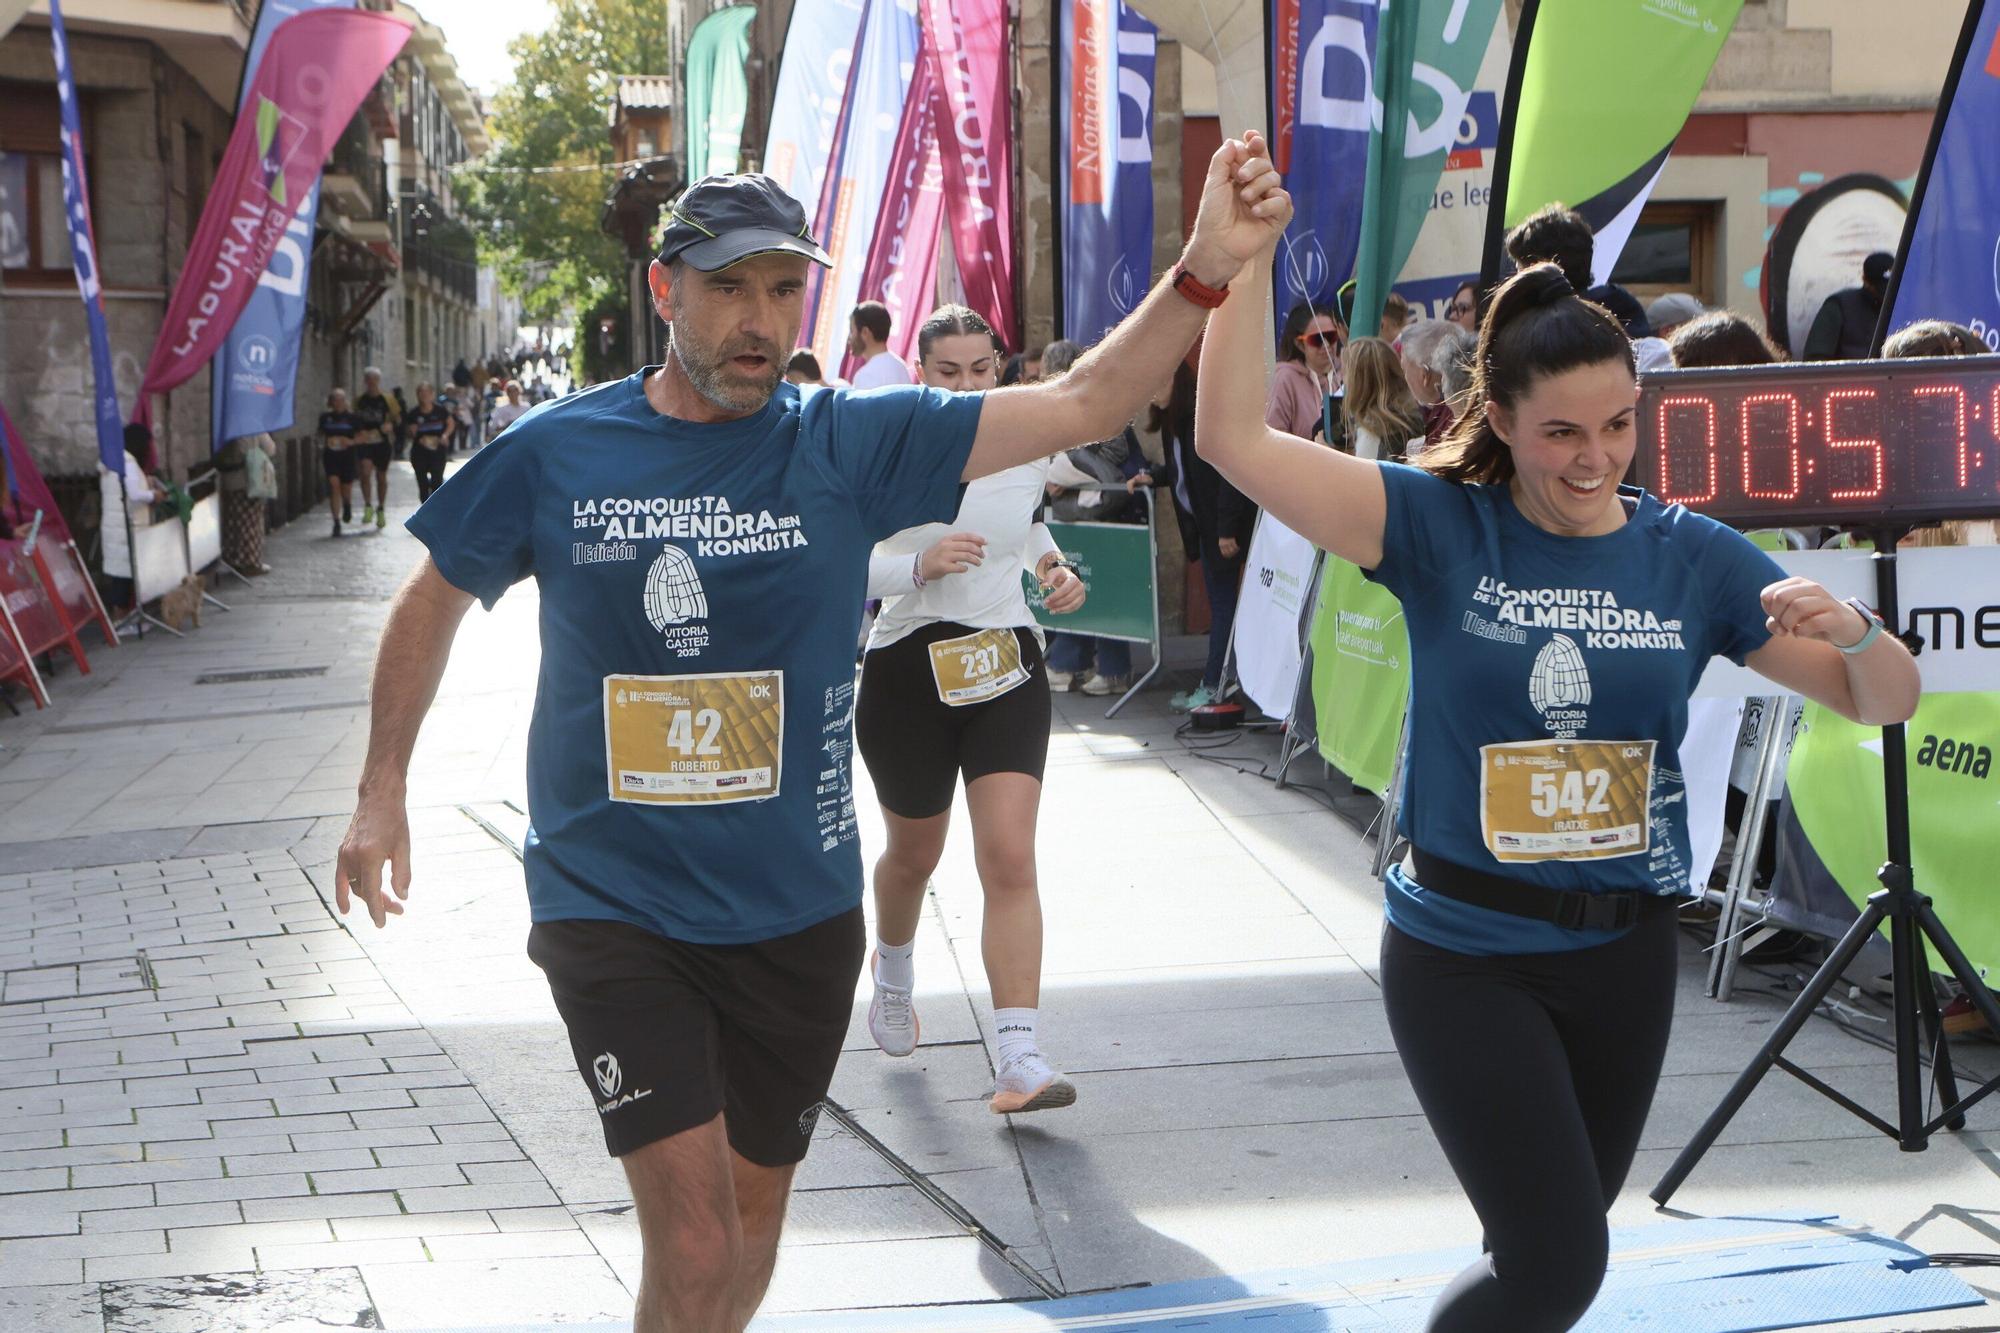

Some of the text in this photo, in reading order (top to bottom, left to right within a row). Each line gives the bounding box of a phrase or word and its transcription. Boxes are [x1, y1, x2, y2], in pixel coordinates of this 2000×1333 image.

[1077, 65, 1099, 175] Noticias
[573, 496, 731, 518] LA CONQUISTA
[573, 509, 801, 541] DE LA ALMENDRA REN
[584, 541, 637, 564] Edición
[697, 529, 809, 557] KONKISTA
[1477, 575, 1619, 609] LA CONQUISTA
[1472, 590, 1490, 604] DE
[1497, 600, 1663, 632] ALMENDRA
[664, 625, 709, 639] VITORIA
[1474, 616, 1527, 645] Edición
[1586, 631, 1686, 651] KONKISTA
[665, 636, 710, 650] GASTEIZ
[677, 648, 701, 658] 2025
[960, 643, 999, 680] 237
[1544, 710, 1588, 720] VITORIA
[1544, 720, 1587, 730] GASTEIZ
[666, 708, 722, 756] 42
[1554, 730, 1577, 739] 2025
[671, 760, 720, 772] ROBERTO
[1916, 734, 1993, 780] aena
[1530, 768, 1611, 818] 542
[1553, 819, 1590, 832] IRATXE
[998, 1024, 1033, 1034] adidas
